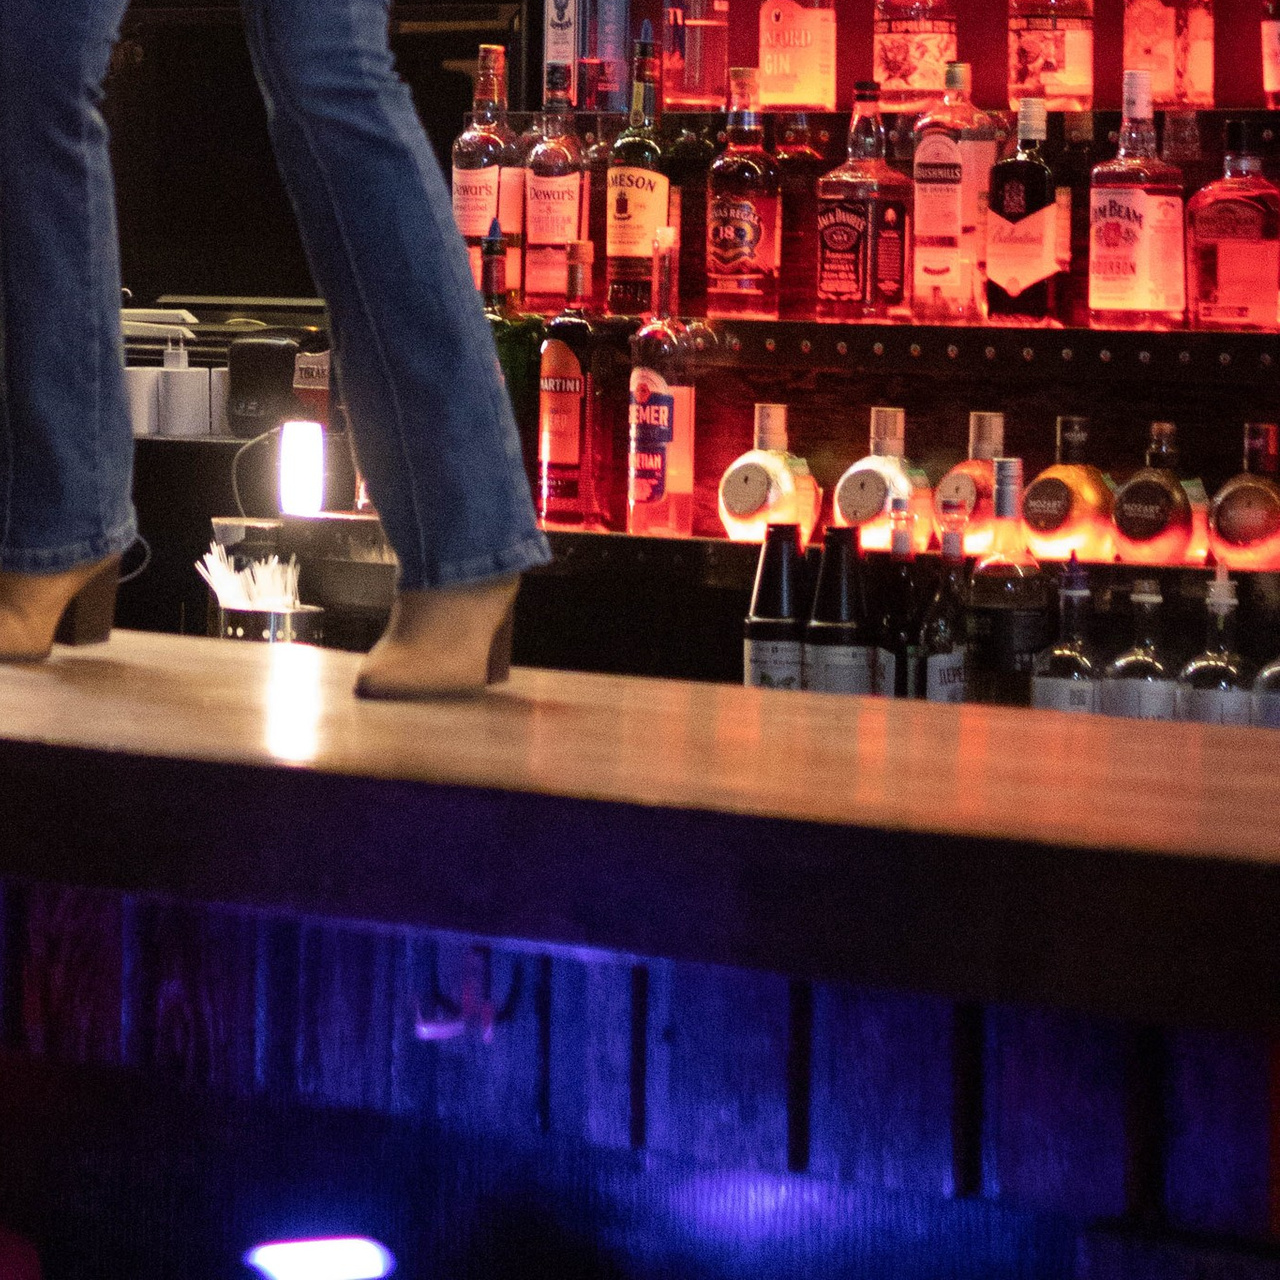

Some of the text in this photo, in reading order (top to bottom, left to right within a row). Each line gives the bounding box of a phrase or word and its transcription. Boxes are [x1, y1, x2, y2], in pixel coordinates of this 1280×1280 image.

[764, 54, 790, 75] GIN
[918, 167, 961, 178] BUSHMILLS
[529, 186, 575, 201] Dewar's
[1108, 199, 1143, 229] BEAM
